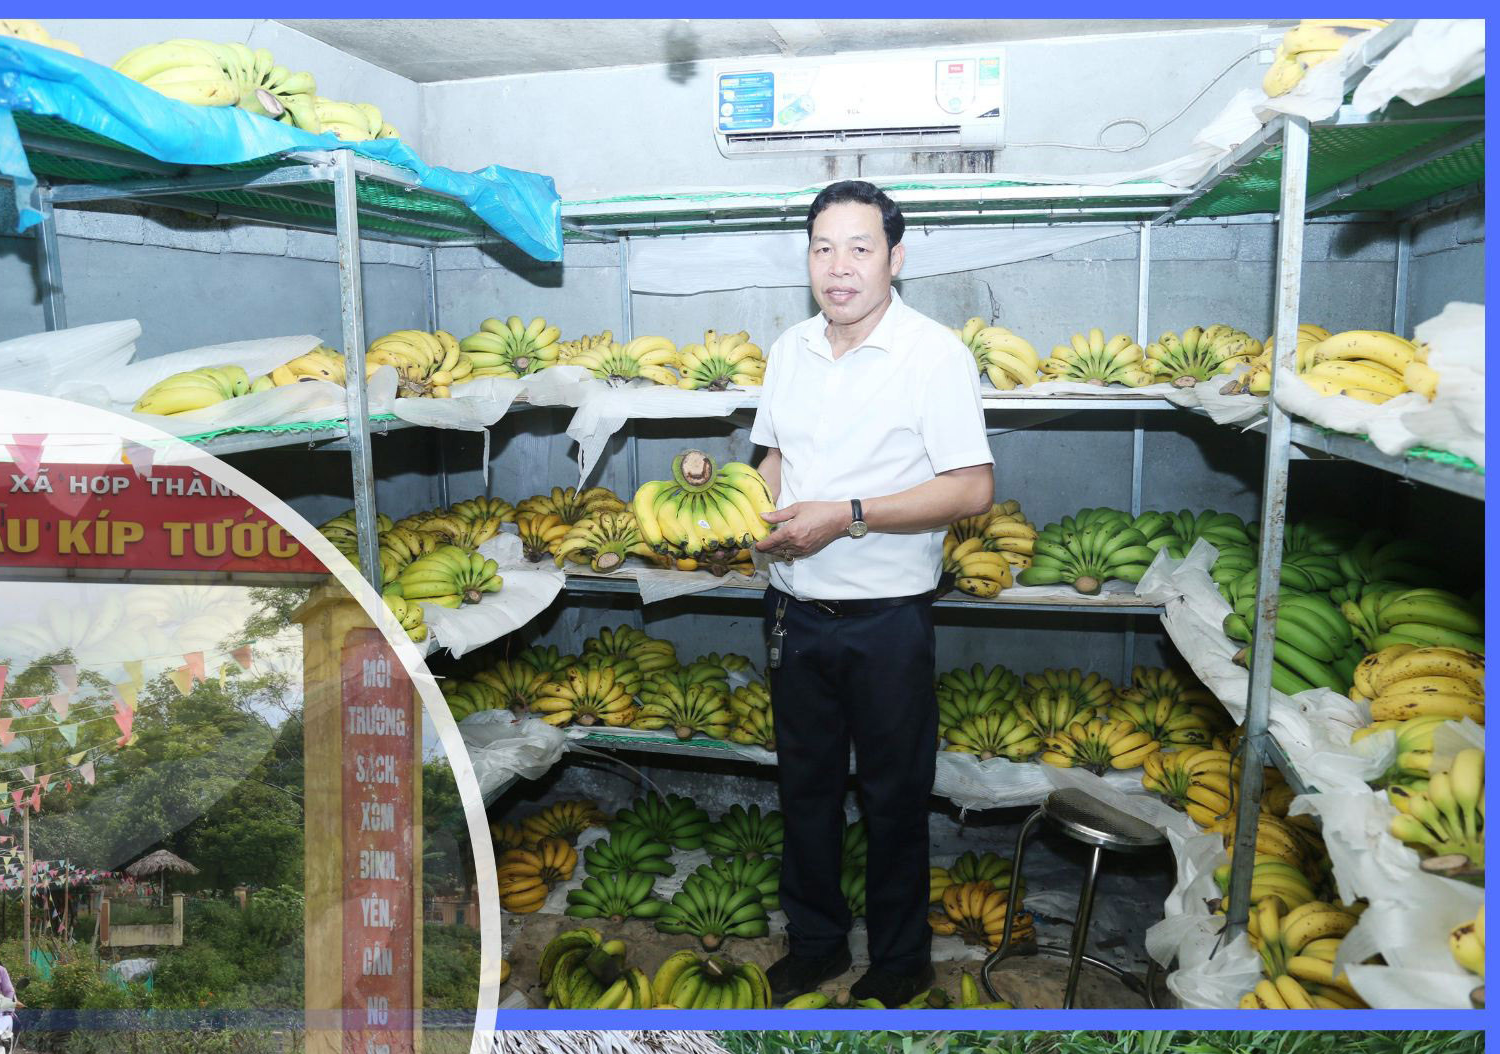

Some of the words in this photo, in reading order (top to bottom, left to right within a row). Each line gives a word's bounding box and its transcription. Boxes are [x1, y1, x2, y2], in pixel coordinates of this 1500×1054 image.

[9, 468, 54, 493] XÃ
[146, 471, 239, 497] THÀN
[57, 509, 145, 555] KÍP
[162, 508, 300, 558] TƯỚC
[362, 653, 392, 689] MÔI
[367, 996, 389, 1025] NO
